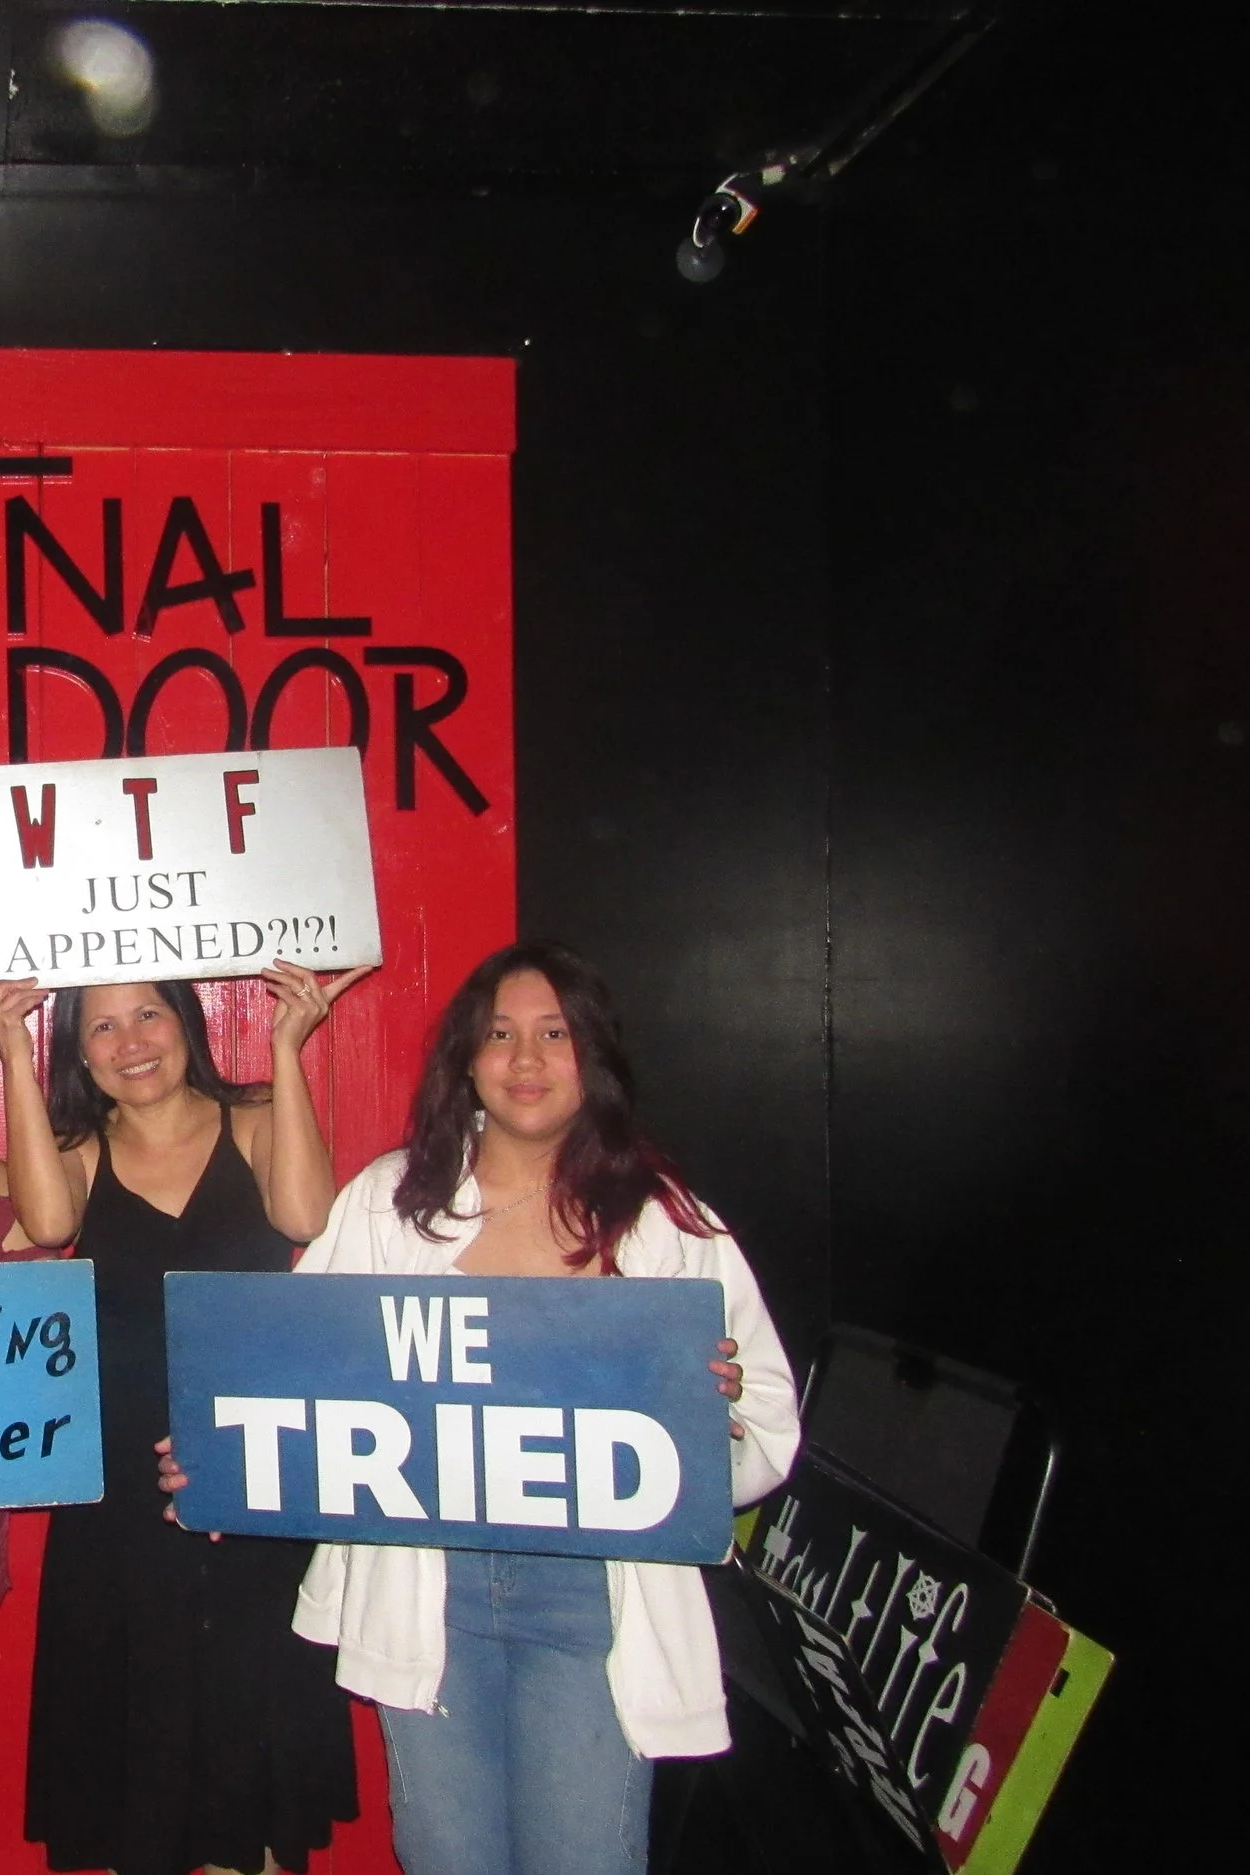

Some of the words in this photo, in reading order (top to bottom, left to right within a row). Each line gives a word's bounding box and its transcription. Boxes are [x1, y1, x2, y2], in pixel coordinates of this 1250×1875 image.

[7, 646, 491, 817] DOOR
[82, 871, 208, 914] JUST
[380, 1296, 492, 1384] WE
[214, 1396, 681, 1531] TRIED
